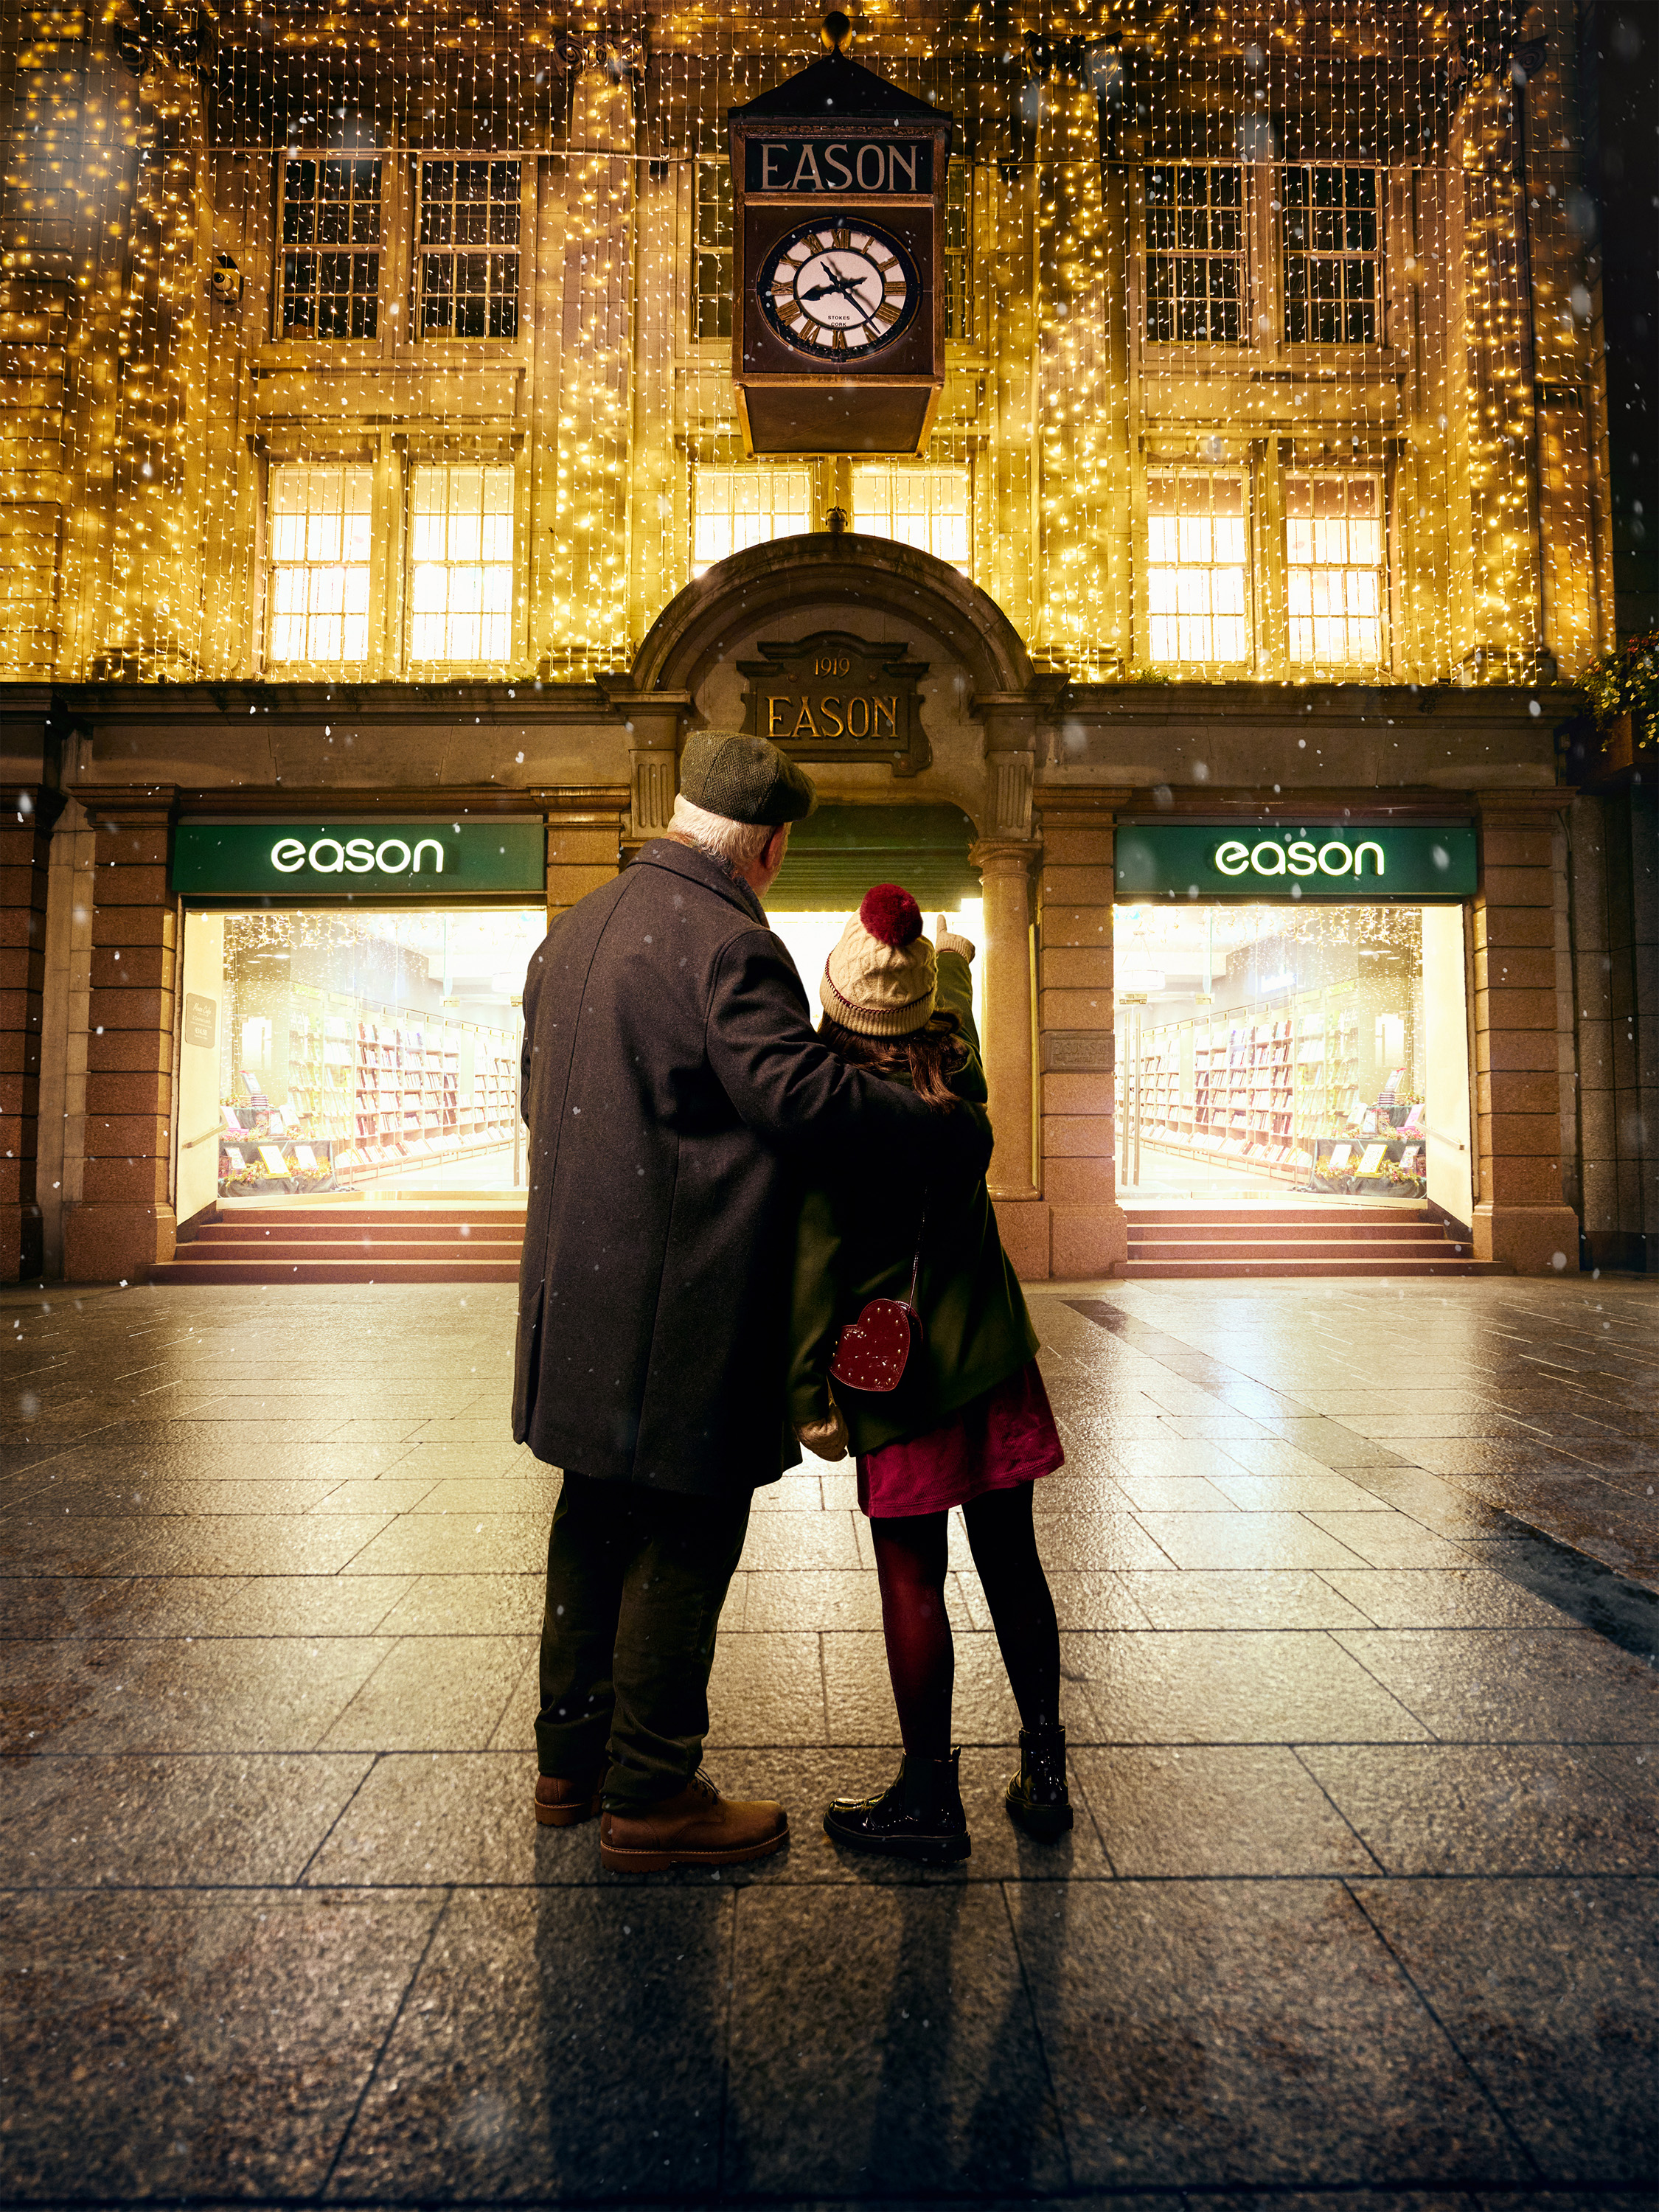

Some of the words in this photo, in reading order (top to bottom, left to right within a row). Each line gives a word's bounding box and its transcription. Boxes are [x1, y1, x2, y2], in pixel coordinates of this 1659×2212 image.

[759, 143, 920, 191] EASON
[815, 657, 850, 677] 1919
[765, 696, 899, 737] EASON
[271, 838, 444, 873] eason
[1215, 841, 1385, 876] eason
